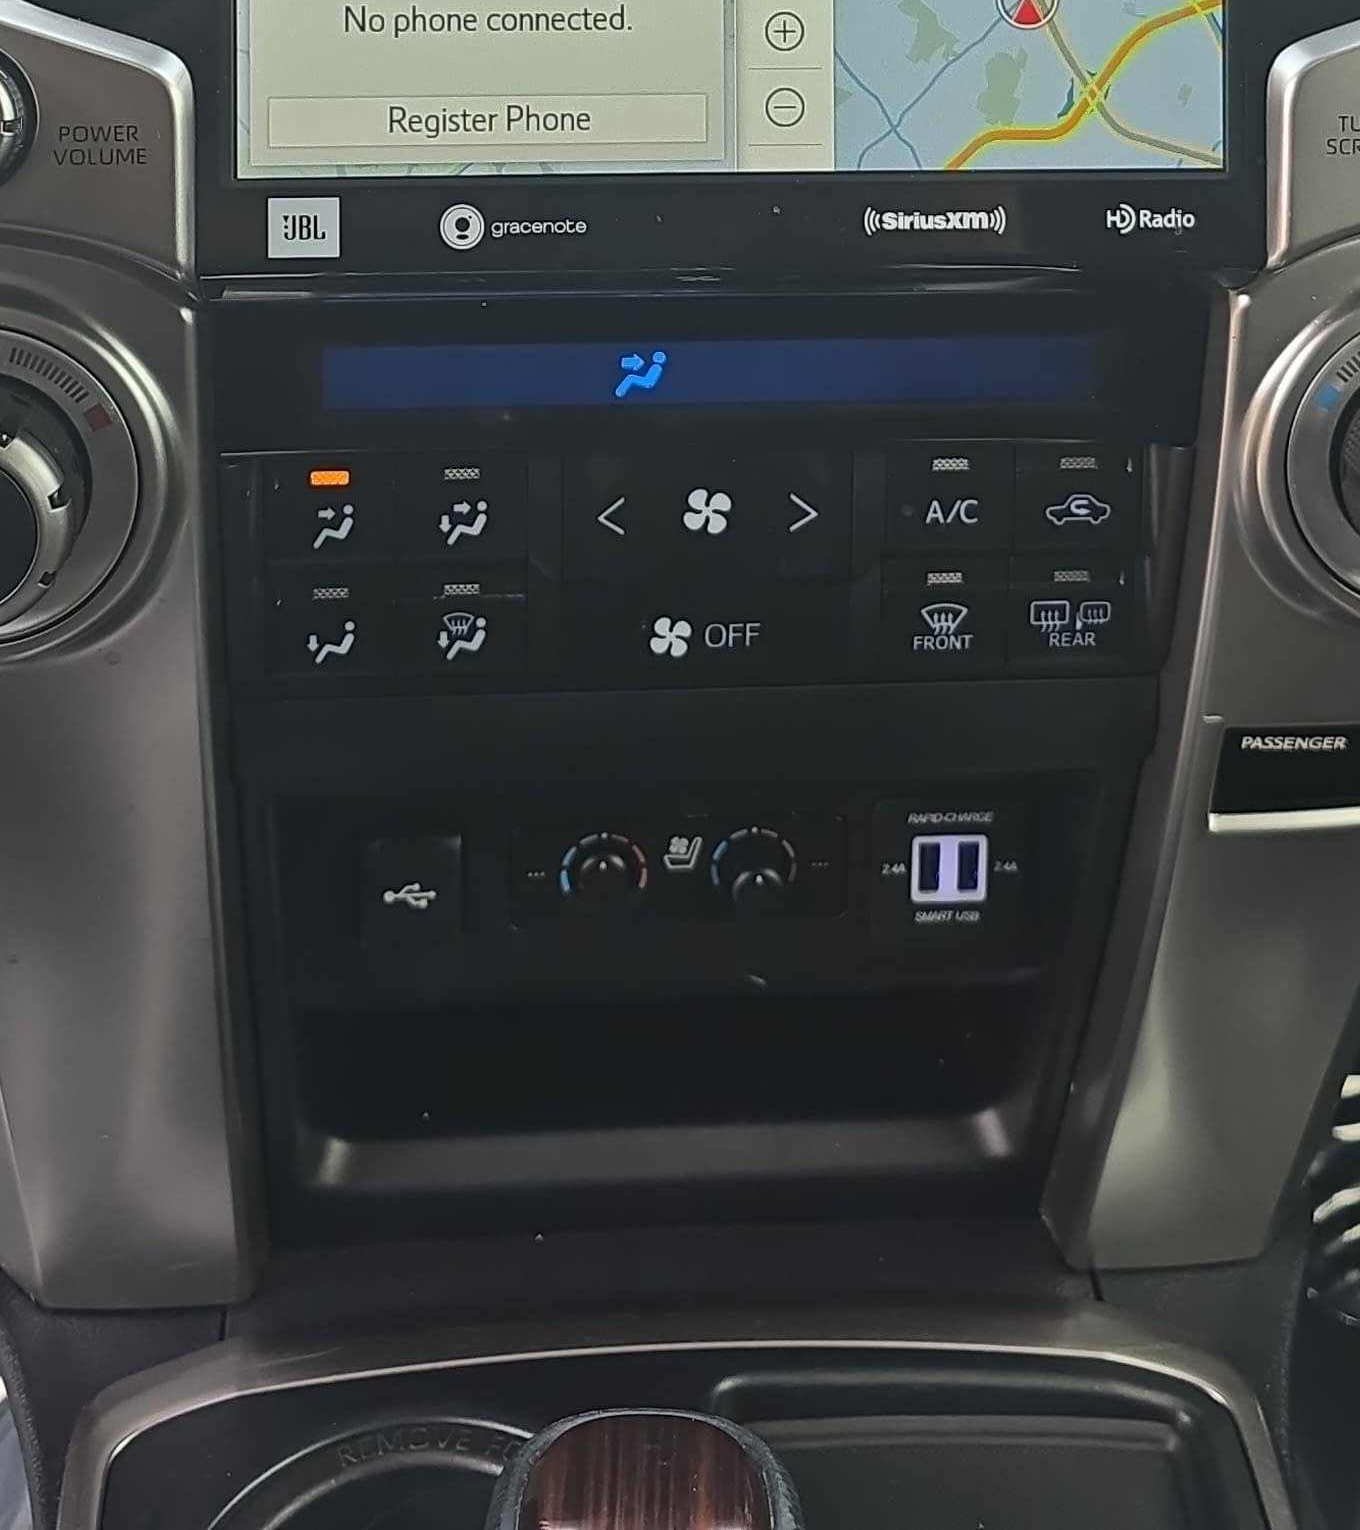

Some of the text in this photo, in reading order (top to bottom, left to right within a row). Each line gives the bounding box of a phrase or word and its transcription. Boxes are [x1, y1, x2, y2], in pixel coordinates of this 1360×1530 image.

[344, 3, 633, 39] No phone connected.
[389, 104, 591, 135] Register Phone
[58, 125, 139, 143] POWER
[52, 147, 147, 166] VOLUME
[282, 214, 326, 241] JBL
[1139, 207, 1196, 229] Radio
[491, 219, 587, 238] gracenote
[925, 499, 979, 524] A/C
[704, 622, 761, 648] OFF
[912, 633, 973, 652] FRONT
[1048, 630, 1097, 647] REAR
[1240, 736, 1347, 751] PASSENGER
[914, 910, 980, 923] SMART USB
